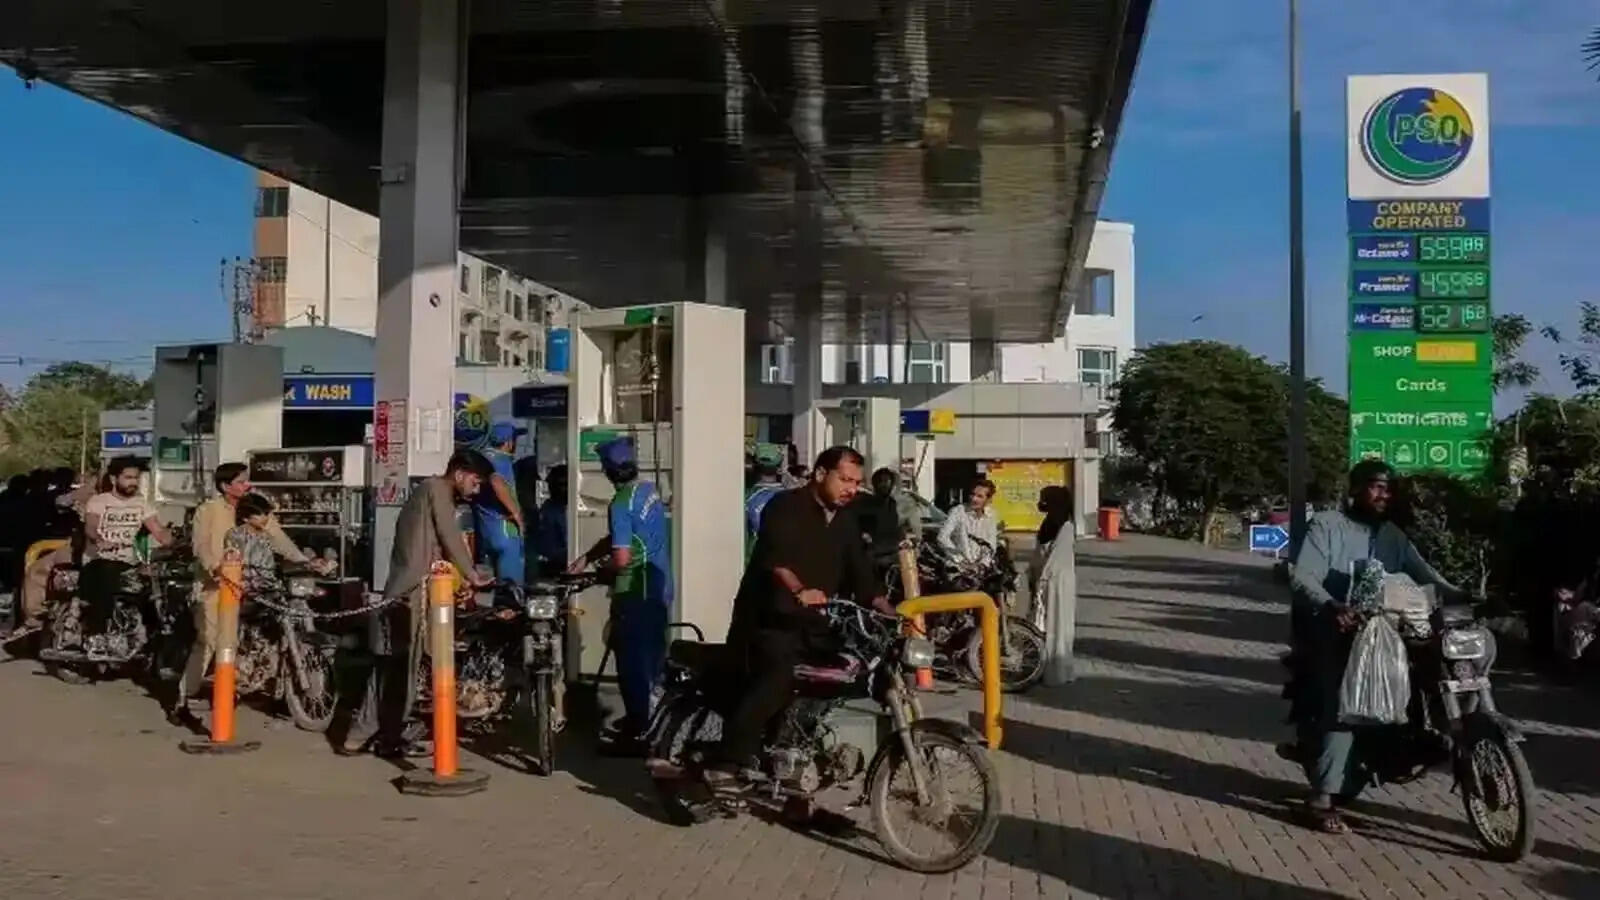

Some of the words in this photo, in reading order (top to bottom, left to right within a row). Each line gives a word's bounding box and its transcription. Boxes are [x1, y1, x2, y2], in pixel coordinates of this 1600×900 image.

[1394, 112, 1462, 145] PSO
[1377, 201, 1463, 215] COMPANY
[1372, 215, 1466, 229] OPERATED
[1373, 345, 1412, 357] SHOP
[305, 383, 352, 401] WASH
[1395, 378, 1447, 392] Cards
[1375, 411, 1468, 427] Lubricants
